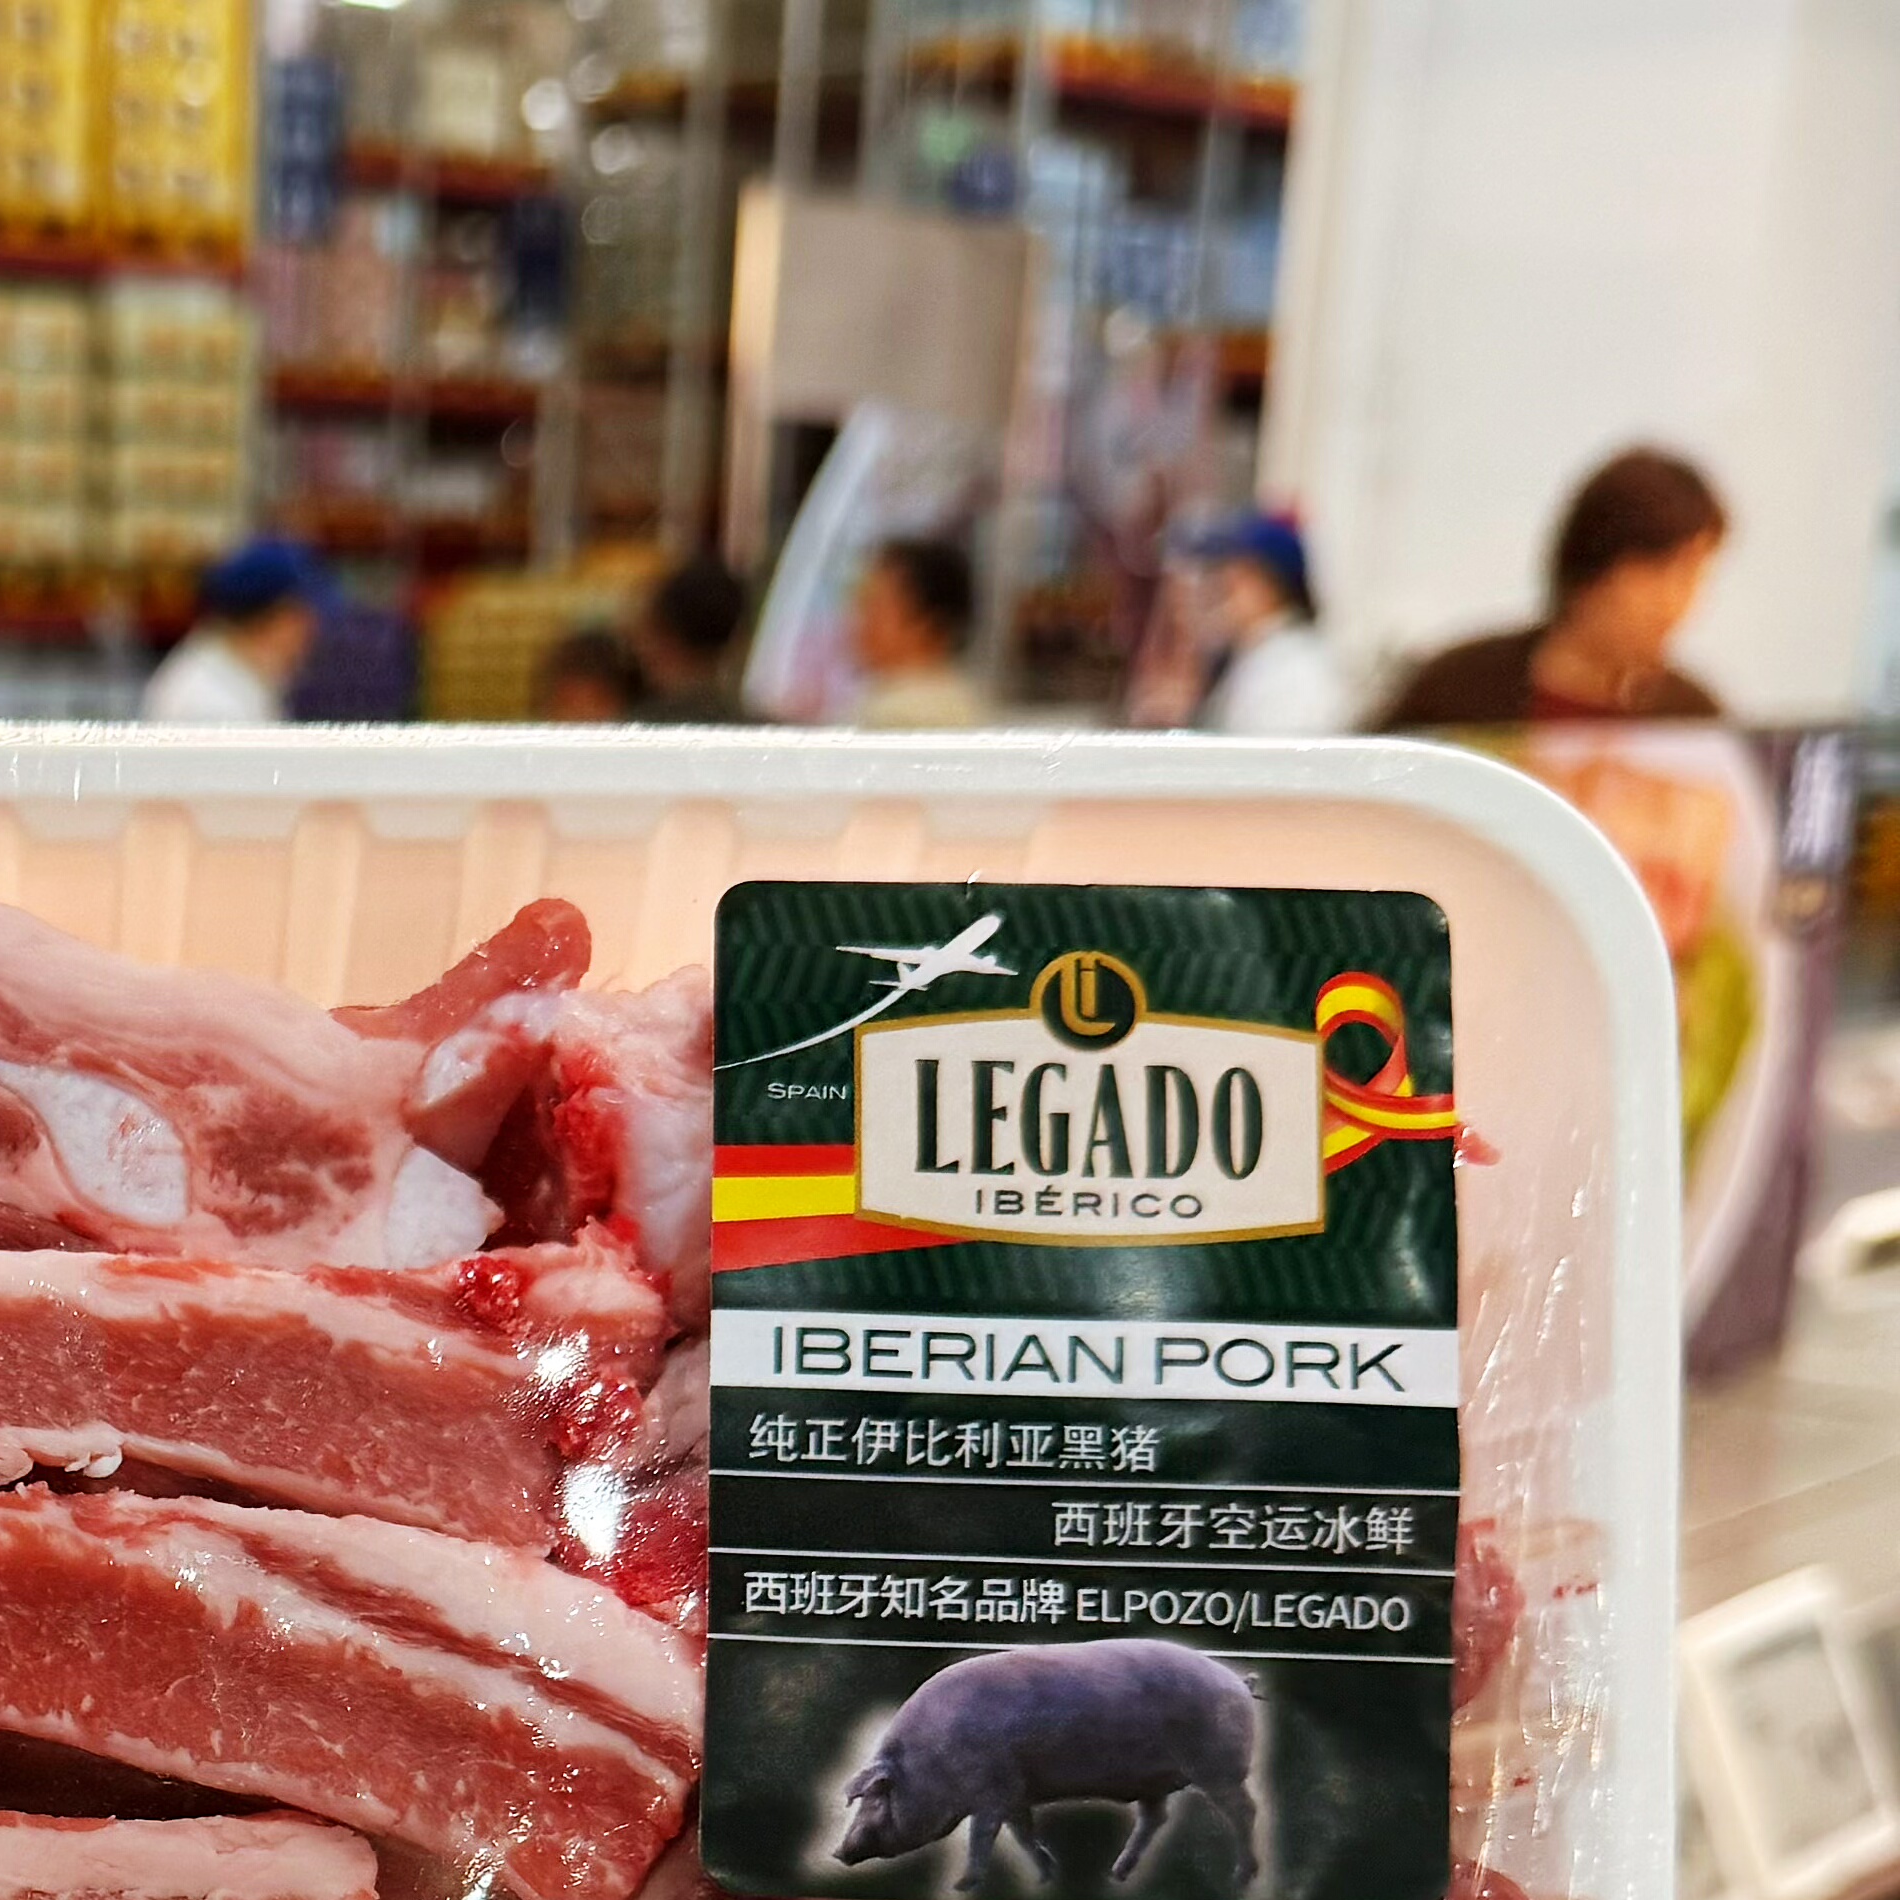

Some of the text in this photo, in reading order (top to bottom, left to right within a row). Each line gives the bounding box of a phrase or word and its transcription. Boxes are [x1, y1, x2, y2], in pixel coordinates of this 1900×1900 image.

[766, 1081, 848, 1101] SPAIN
[915, 1057, 1263, 1181] LEGADO
[974, 1181, 1202, 1219] IBÉRICO
[772, 1326, 1406, 1393] IBERIAN PORK
[748, 1412, 1161, 1473] 纯正伊比利亚黑猪
[1051, 1500, 1414, 1556] 西班牙空运冰鲜
[743, 1570, 1411, 1633] 西班牙知名品牌 ELPOZO/LEGADO
